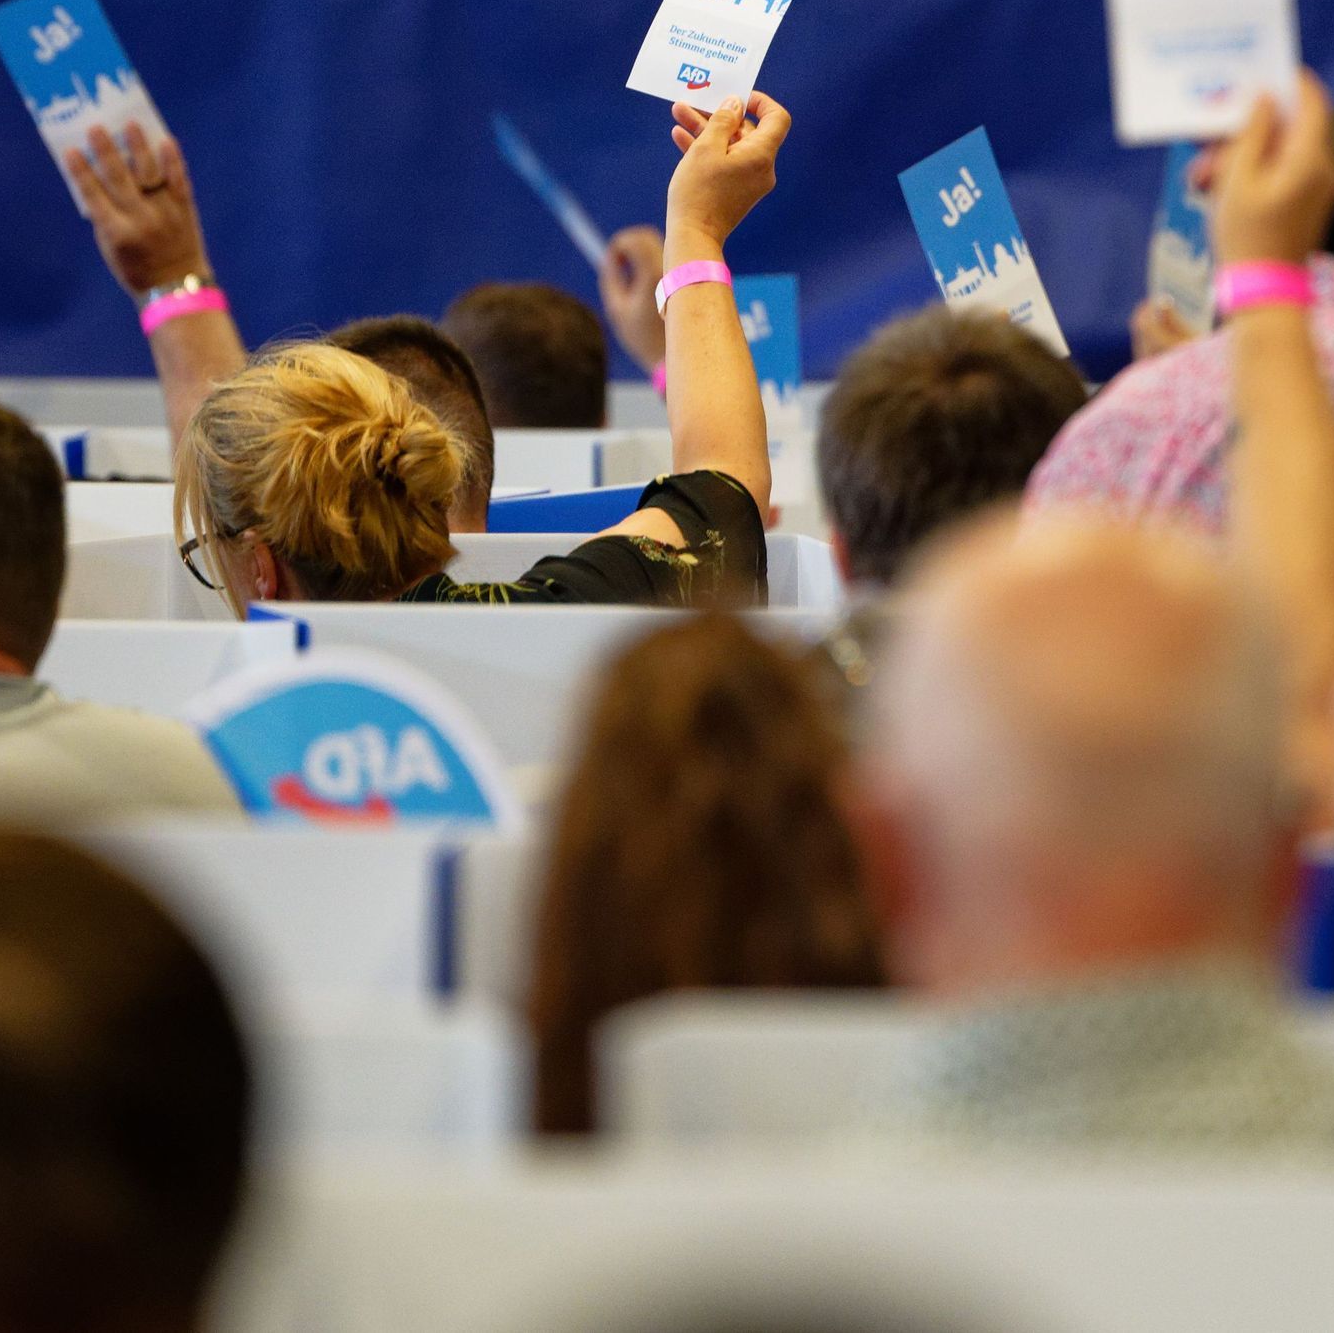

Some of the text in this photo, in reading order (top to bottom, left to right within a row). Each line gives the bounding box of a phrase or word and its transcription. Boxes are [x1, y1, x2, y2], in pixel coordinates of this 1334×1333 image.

[30, 5, 81, 64] Ja!
[669, 24, 747, 54] Der Zukunft eine
[668, 36, 739, 64] Stimme geben!
[679, 66, 707, 84] AfD
[938, 165, 983, 228] Ja!
